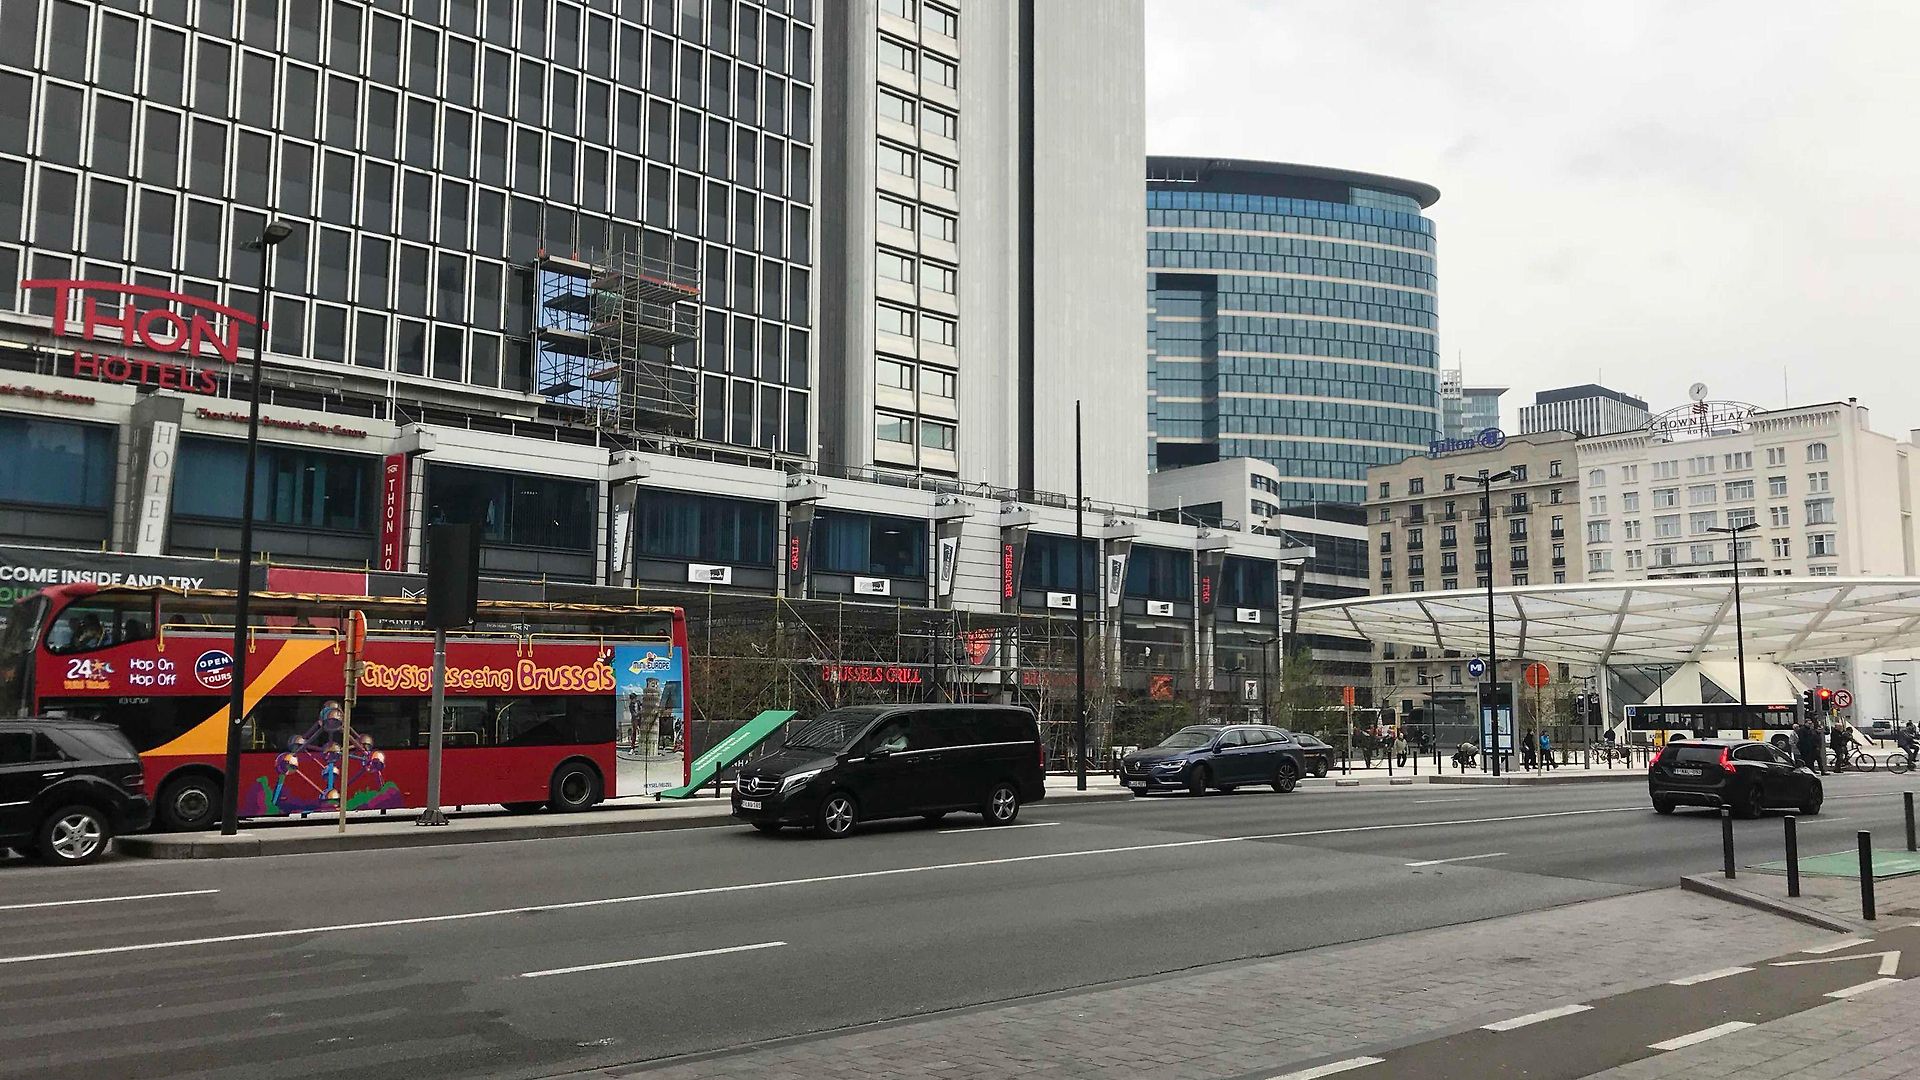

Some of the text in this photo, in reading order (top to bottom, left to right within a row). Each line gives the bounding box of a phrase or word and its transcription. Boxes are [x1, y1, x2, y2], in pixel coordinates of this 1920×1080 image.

[21, 279, 269, 363] THON
[73, 351, 217, 394] HOTELS
[1651, 410, 1754, 430] CROWNE PLAZA
[1429, 437, 1476, 454] Hilton
[145, 426, 172, 542] HOTEL
[386, 479, 396, 533] THON
[0, 565, 204, 591] COME INSIDE AND TRY
[1004, 543, 1013, 598] BRUSSELS
[66, 658, 92, 679] 24
[130, 658, 174, 672] Hop On
[200, 656, 229, 669] OPEN
[130, 673, 177, 687] Hop Off
[202, 672, 232, 684] TOURS
[517, 659, 617, 692] Brussels
